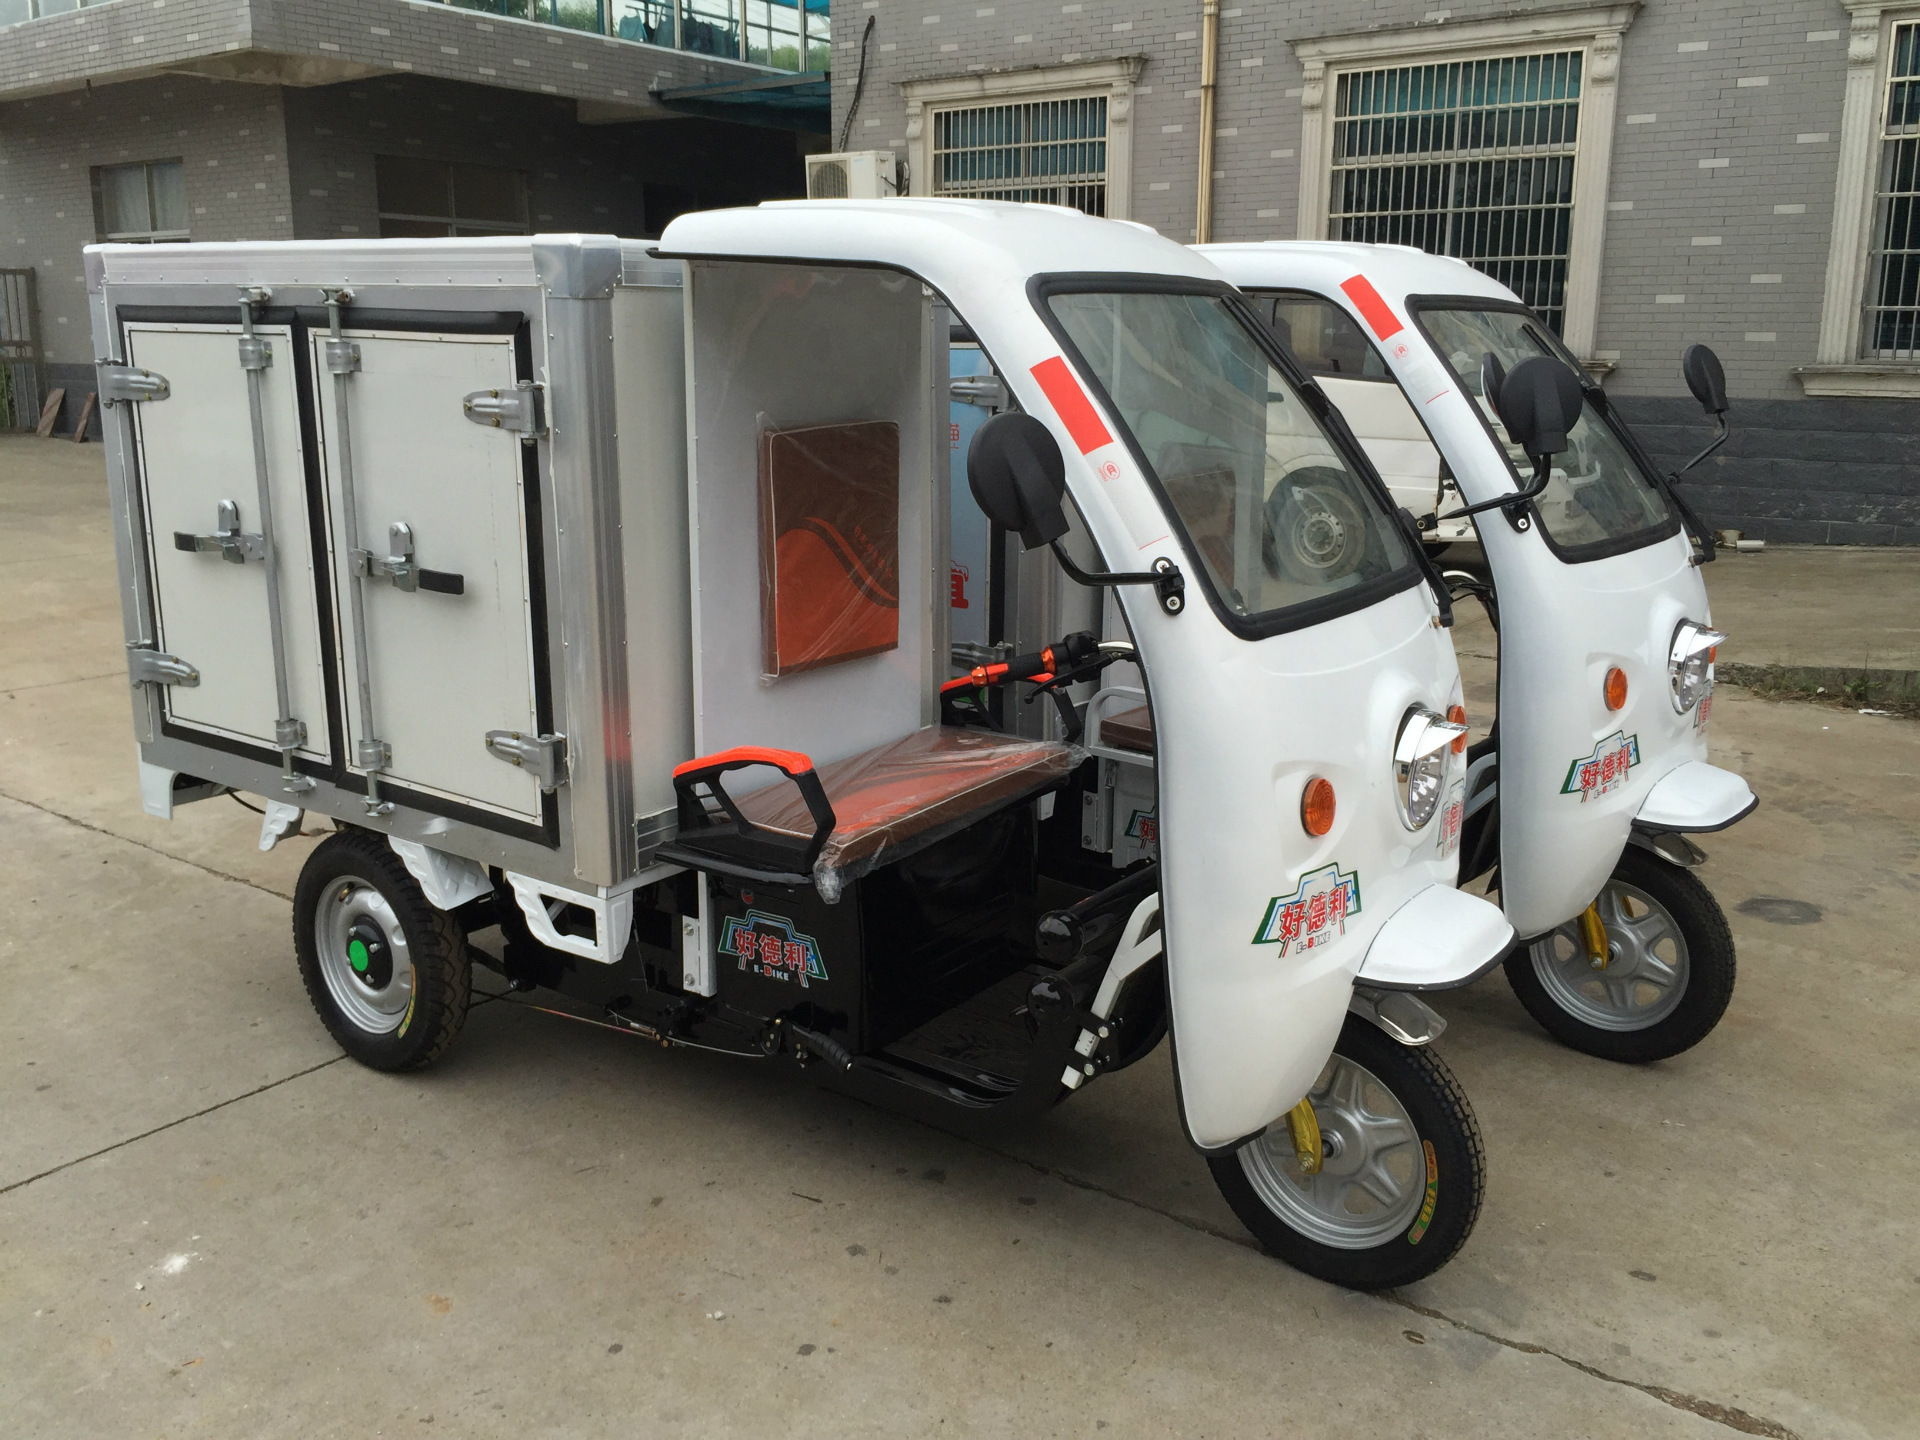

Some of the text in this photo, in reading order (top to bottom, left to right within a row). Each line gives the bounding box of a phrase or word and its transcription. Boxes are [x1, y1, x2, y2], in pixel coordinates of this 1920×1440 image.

[1580, 744, 1630, 791] 好德利
[1279, 882, 1348, 942] 好德利
[735, 927, 807, 973] 好德利
[1296, 931, 1331, 954] E-BIKE
[753, 964, 790, 981] E-BIKE
